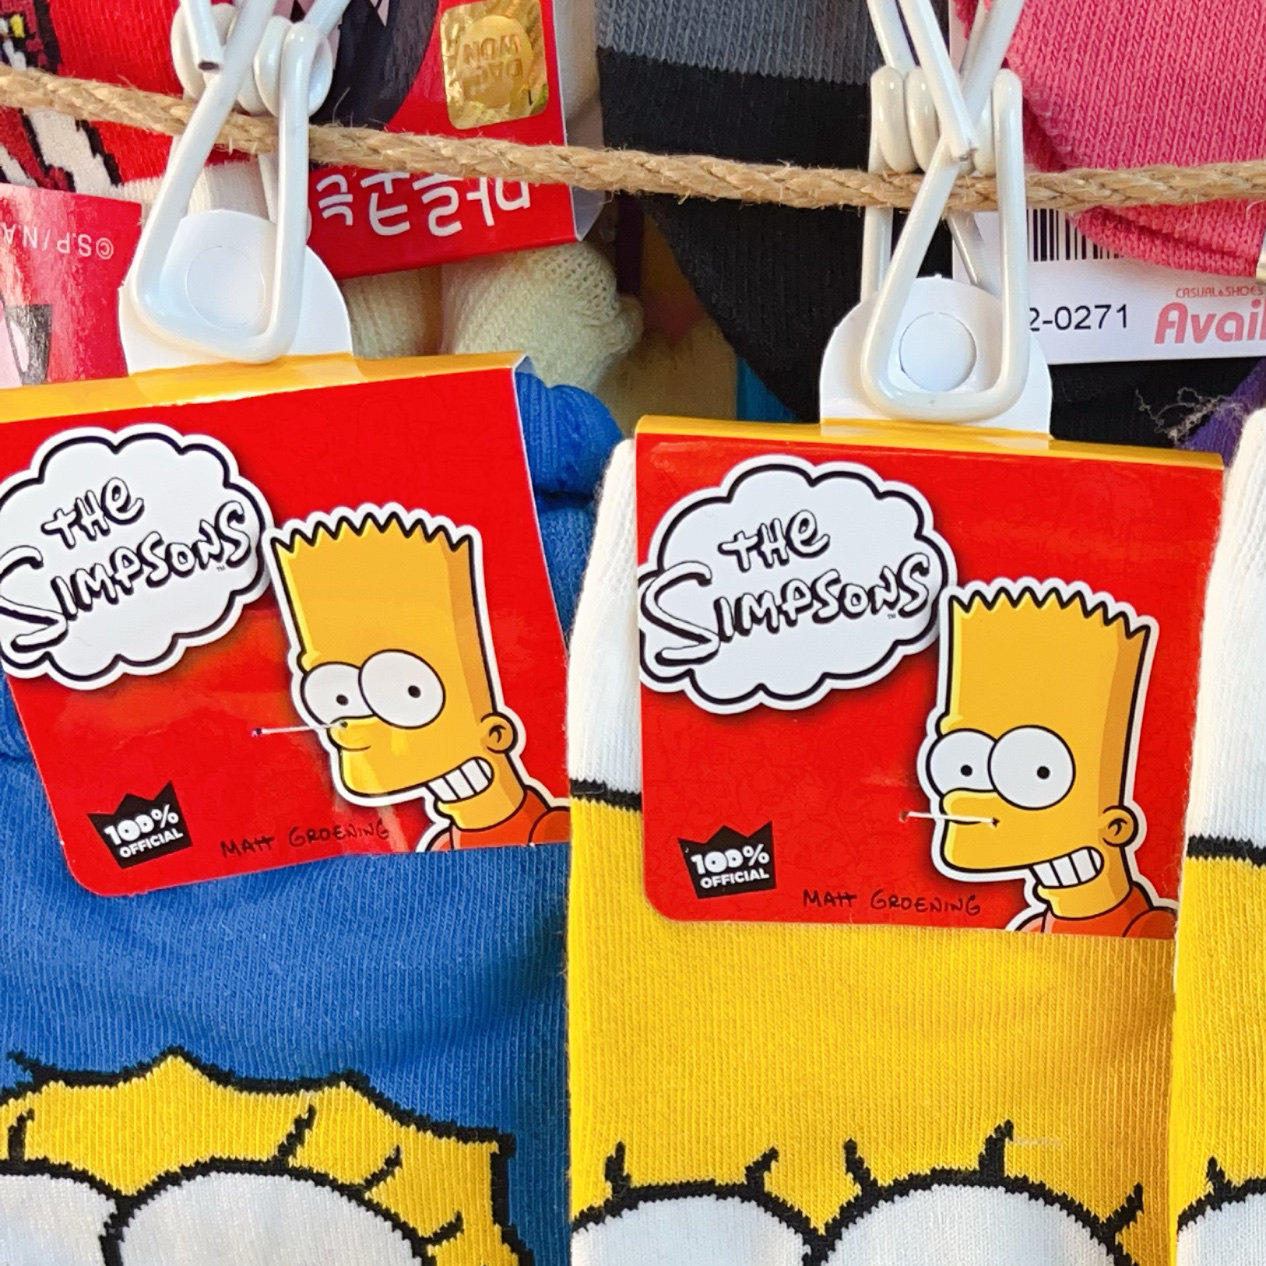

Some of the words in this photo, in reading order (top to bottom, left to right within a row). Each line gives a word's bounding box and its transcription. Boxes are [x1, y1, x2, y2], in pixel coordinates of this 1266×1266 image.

[104, 804, 180, 846] 100%
[119, 828, 184, 859] OFFICIAL
[691, 843, 770, 875] 100%
[700, 868, 770, 889] OFFICIAL
